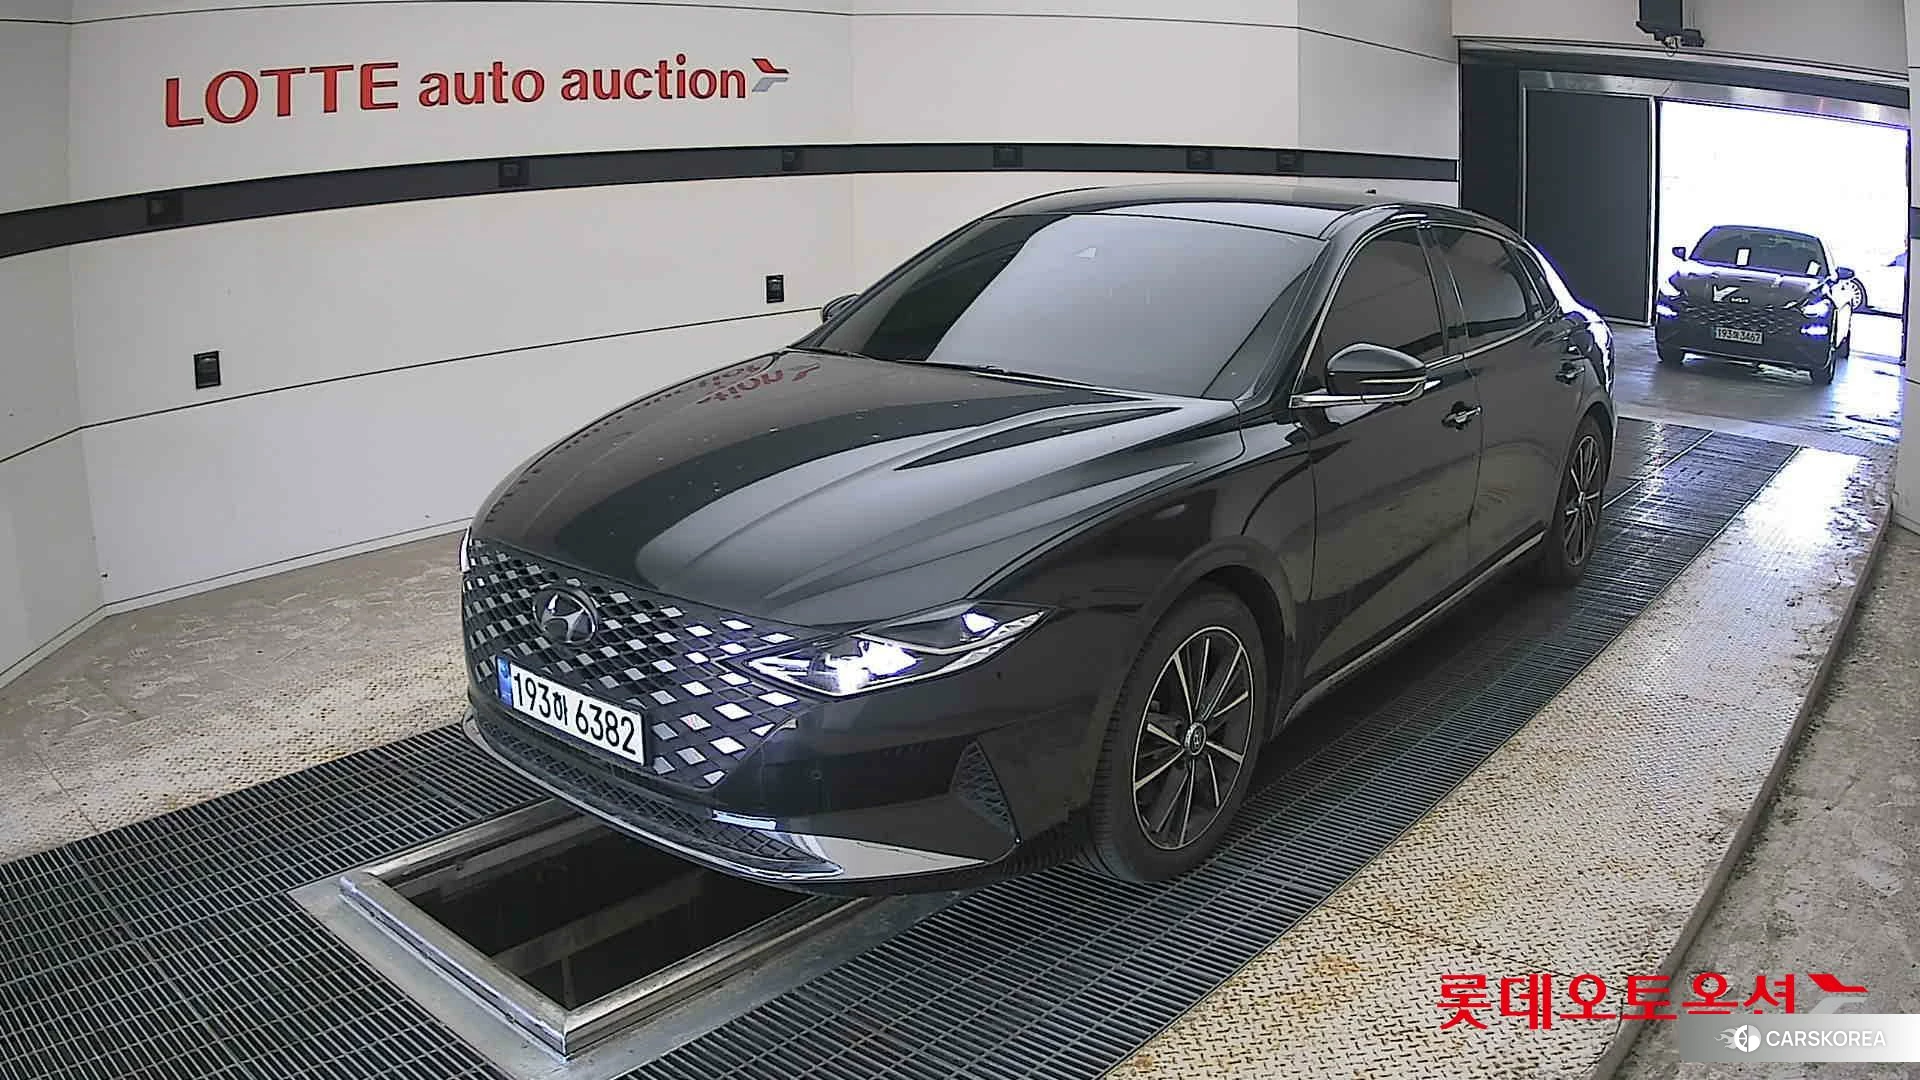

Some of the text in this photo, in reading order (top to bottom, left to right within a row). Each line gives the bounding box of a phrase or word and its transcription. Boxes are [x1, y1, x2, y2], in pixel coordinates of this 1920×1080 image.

[165, 53, 746, 127] LOTTE auto auction
[514, 672, 636, 755] 193하 6382
